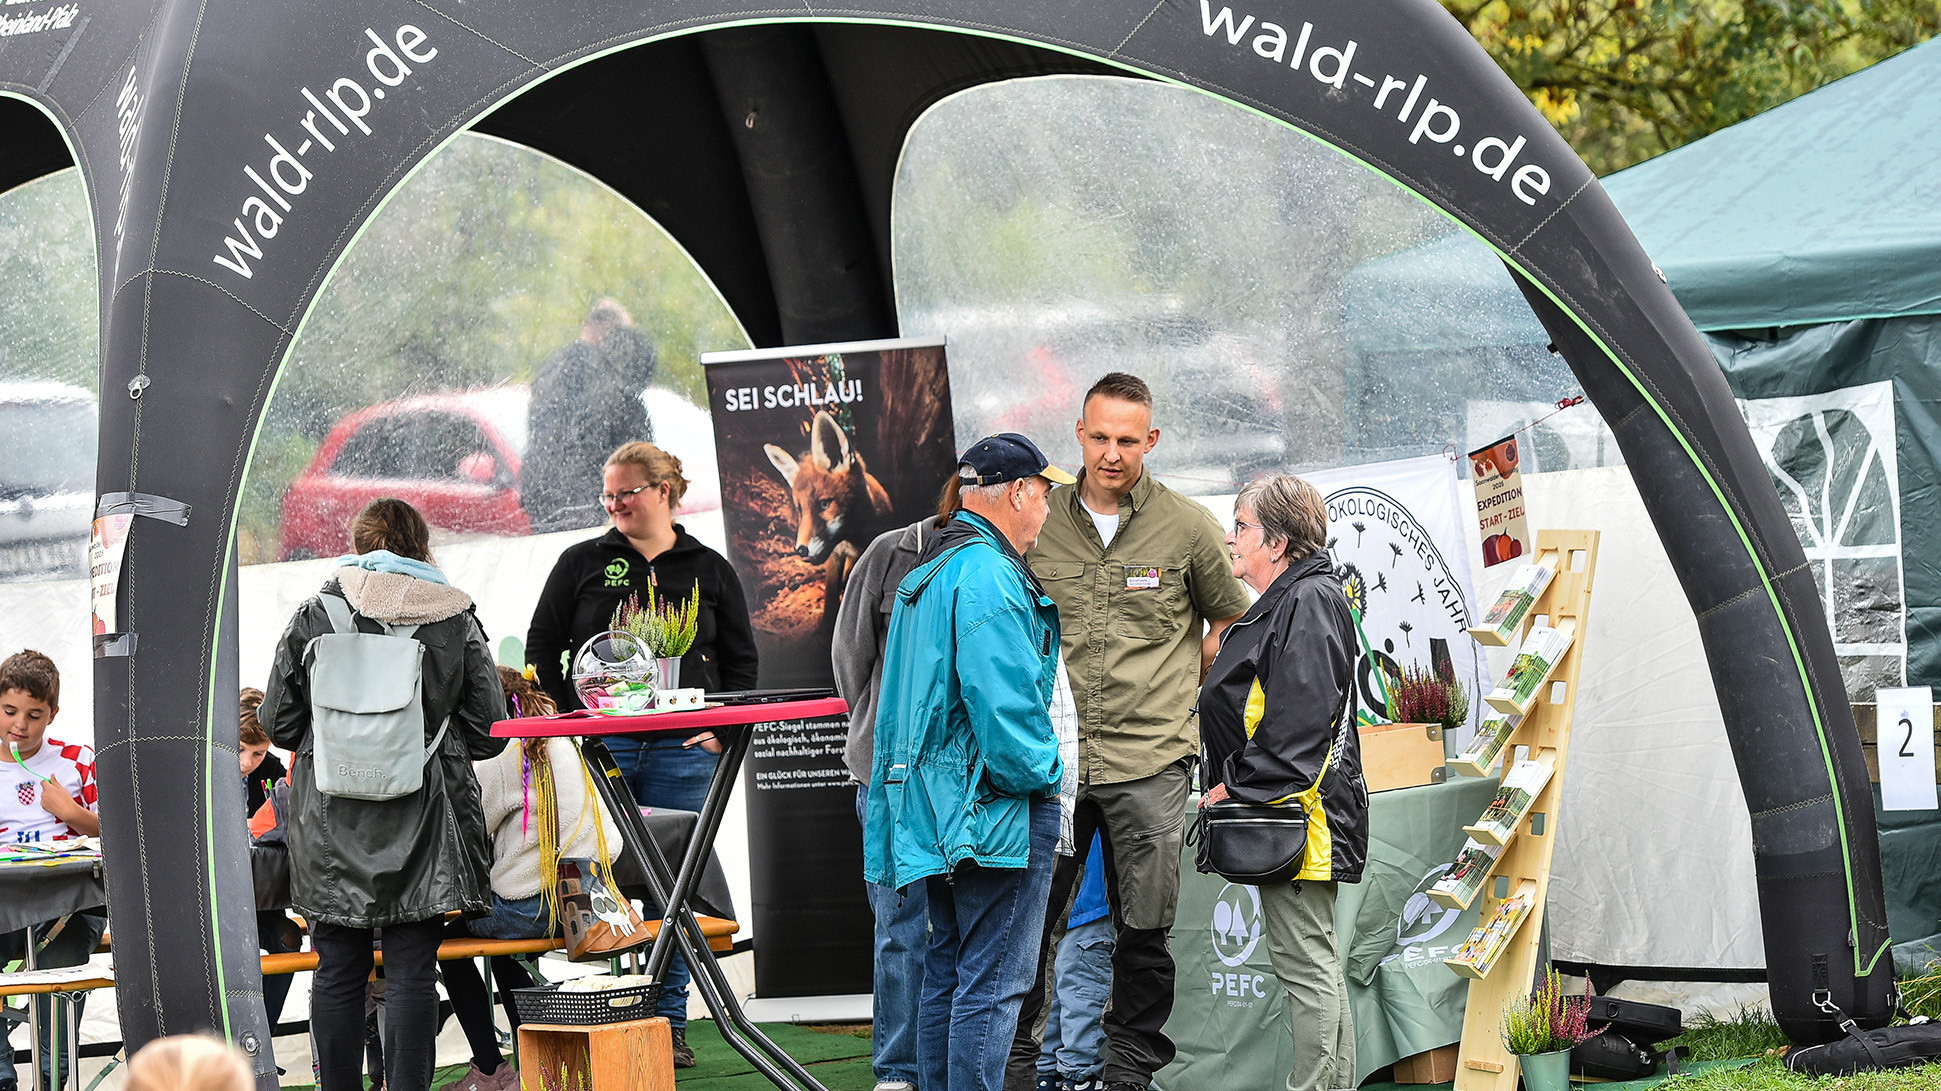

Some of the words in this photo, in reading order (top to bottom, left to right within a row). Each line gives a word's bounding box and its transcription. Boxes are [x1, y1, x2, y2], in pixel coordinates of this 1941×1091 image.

[0, 2, 79, 37] heinland-Pfalz
[1200, 0, 1551, 206] wald-rlp.de
[213, 23, 438, 280] wald-rlp.de
[725, 387, 759, 412] SEI
[764, 379, 864, 409] SCHLAU!
[1477, 486, 1522, 512] EXPEDITION
[1480, 512, 1503, 530] START
[1507, 505, 1525, 521] ZIEL
[90, 561, 119, 579] EDITION
[1328, 498, 1435, 571] ÖKOLOGISCHES
[1433, 577, 1467, 634] JAHR
[604, 579, 630, 588] PEFC
[806, 722, 841, 731] stammen
[1898, 718, 1914, 757] 2
[753, 738, 766, 746] aus
[767, 733, 810, 746] ökologisch,
[754, 746, 775, 759] sozial
[776, 745, 823, 758] nachhaltiger
[338, 764, 386, 780] Bench.
[756, 771, 768, 780] EIN
[768, 769, 792, 780] GLÜCK
[793, 768, 807, 779] FÜR
[807, 769, 840, 778] UNSEREN
[757, 782, 771, 790] Mehr
[772, 781, 811, 789] Informationen
[1211, 972, 1266, 998] PEFC
